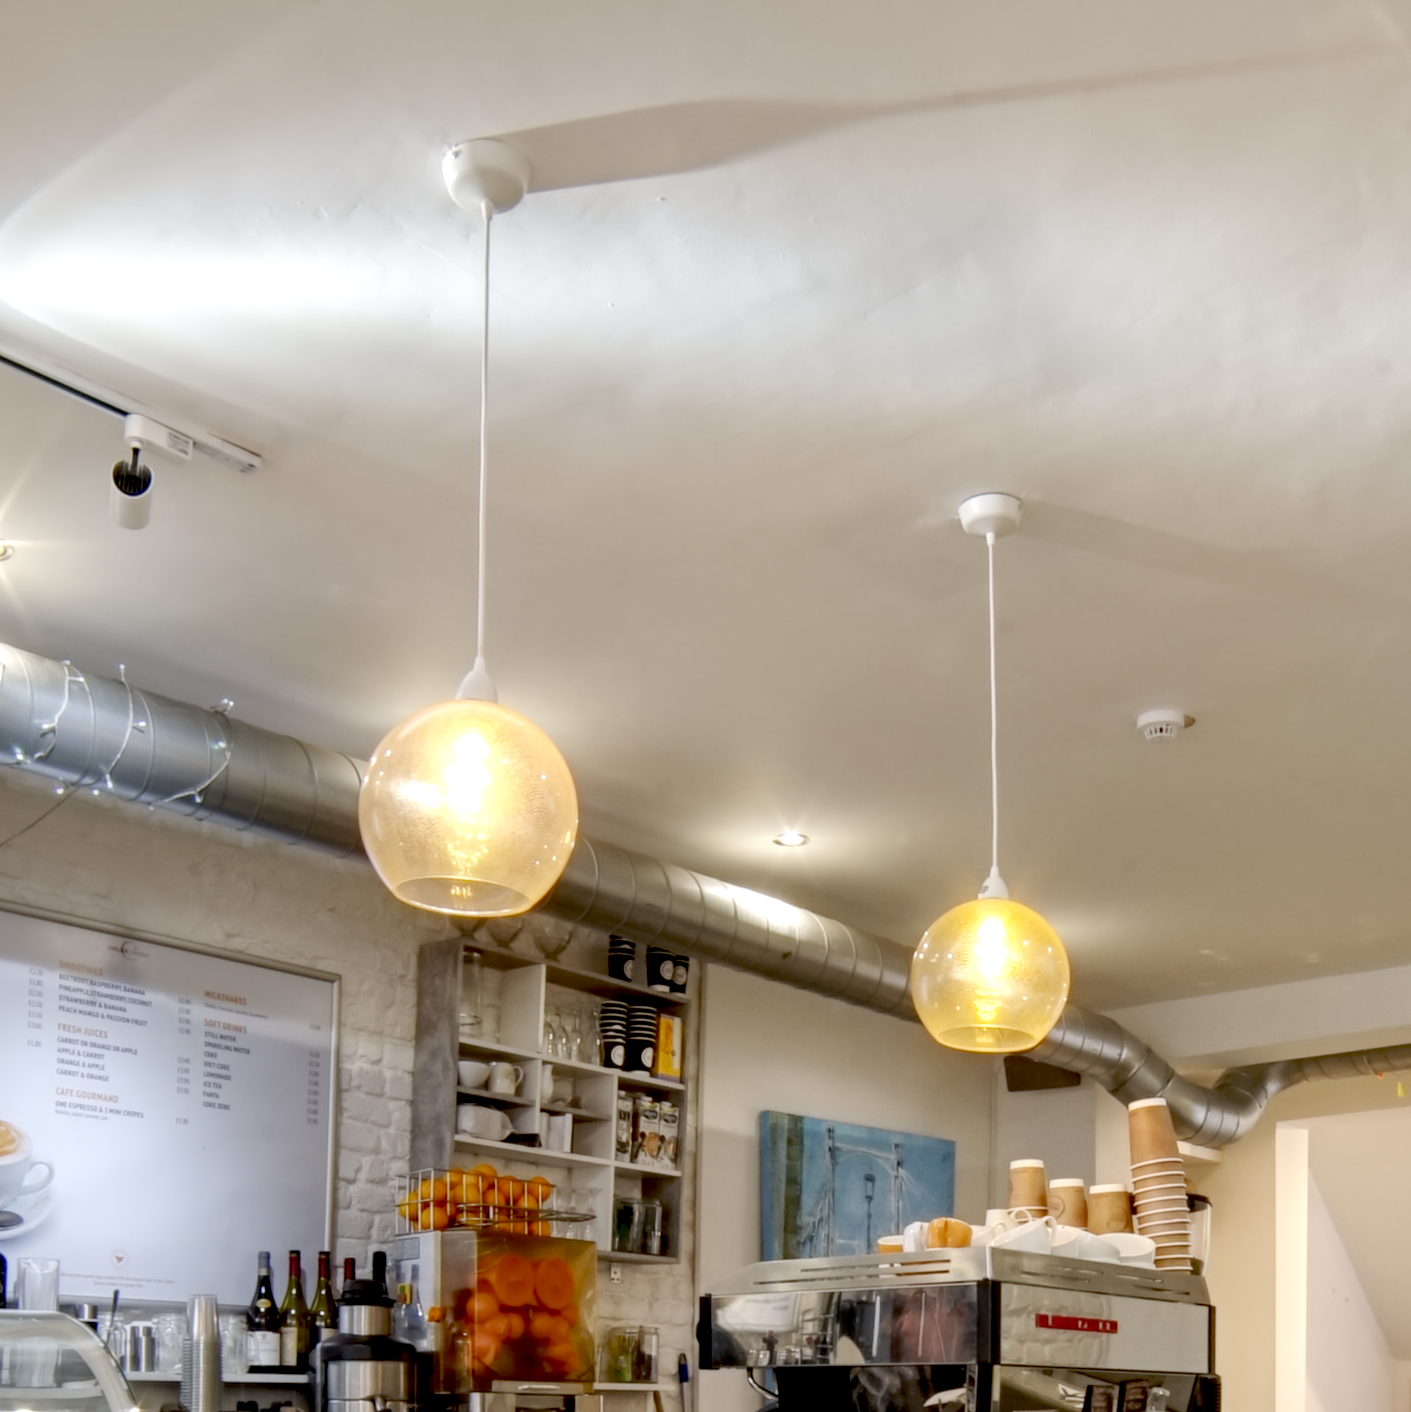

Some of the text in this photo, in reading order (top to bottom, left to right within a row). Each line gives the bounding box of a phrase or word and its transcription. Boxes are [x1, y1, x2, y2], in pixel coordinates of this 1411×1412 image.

[59, 960, 103, 977] SMOOTHIES
[58, 994, 97, 1007] STRAWBERRY
[104, 1003, 127, 1013] BANANA
[205, 990, 247, 1006] MILKSHAKES
[58, 1005, 78, 1015] PEACH
[79, 1009, 100, 1019] MANGO
[106, 1014, 130, 1024] PASSION
[131, 1018, 148, 1027] FRUIT
[58, 1022, 108, 1039] FRESH JUICES
[204, 1019, 247, 1034] SOFT DRINKS
[57, 1036, 79, 1046] CARROT
[89, 1041, 111, 1051] ORANGE
[121, 1046, 138, 1056] APPLE
[57, 1047, 76, 1056] APPLE
[82, 1051, 105, 1060] CARROT
[56, 1058, 80, 1068] ORANGE
[87, 1062, 105, 1071] APPLE
[204, 1060, 216, 1069] DIET
[56, 1068, 79, 1078] CARROT
[86, 1073, 109, 1082] ORANGE
[203, 1071, 232, 1081] LEMONADE
[55, 1087, 119, 1104] CAFE GOURMAND
[55, 1100, 67, 1108] ONE
[68, 1102, 98, 1112] ESPRESSO
[123, 1110, 144, 1119] CREPES
